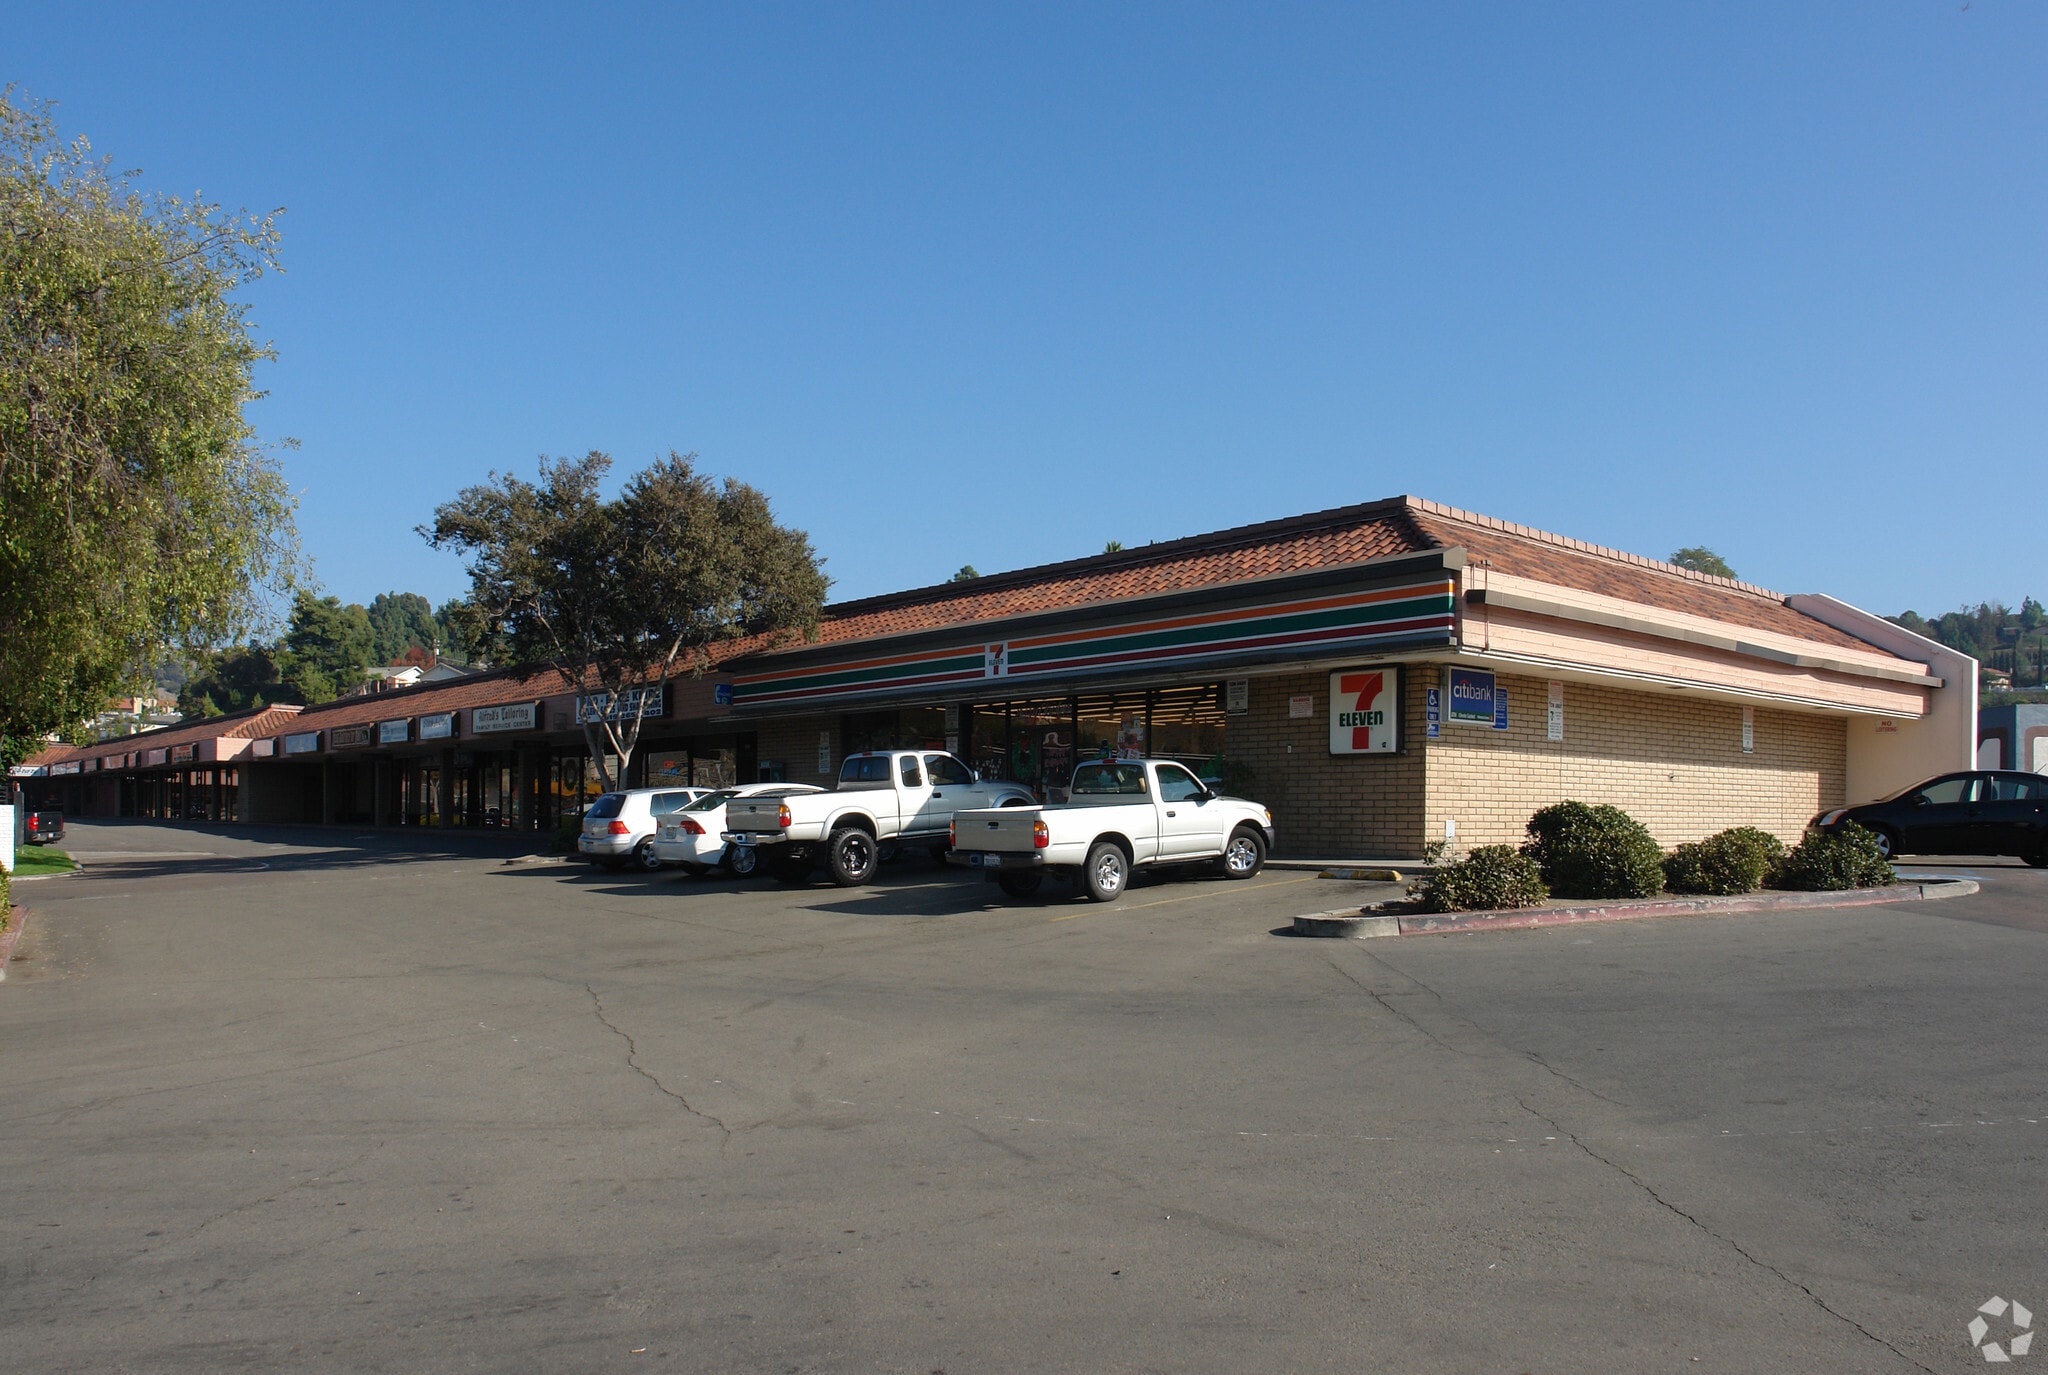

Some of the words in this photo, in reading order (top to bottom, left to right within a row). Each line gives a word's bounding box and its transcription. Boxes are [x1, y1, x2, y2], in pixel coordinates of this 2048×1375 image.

[990, 644, 1003, 675] 7
[1453, 682, 1492, 701] citibank
[479, 708, 499, 721] Alfred's
[501, 706, 529, 721] Tailoring
[1341, 672, 1383, 750] 7
